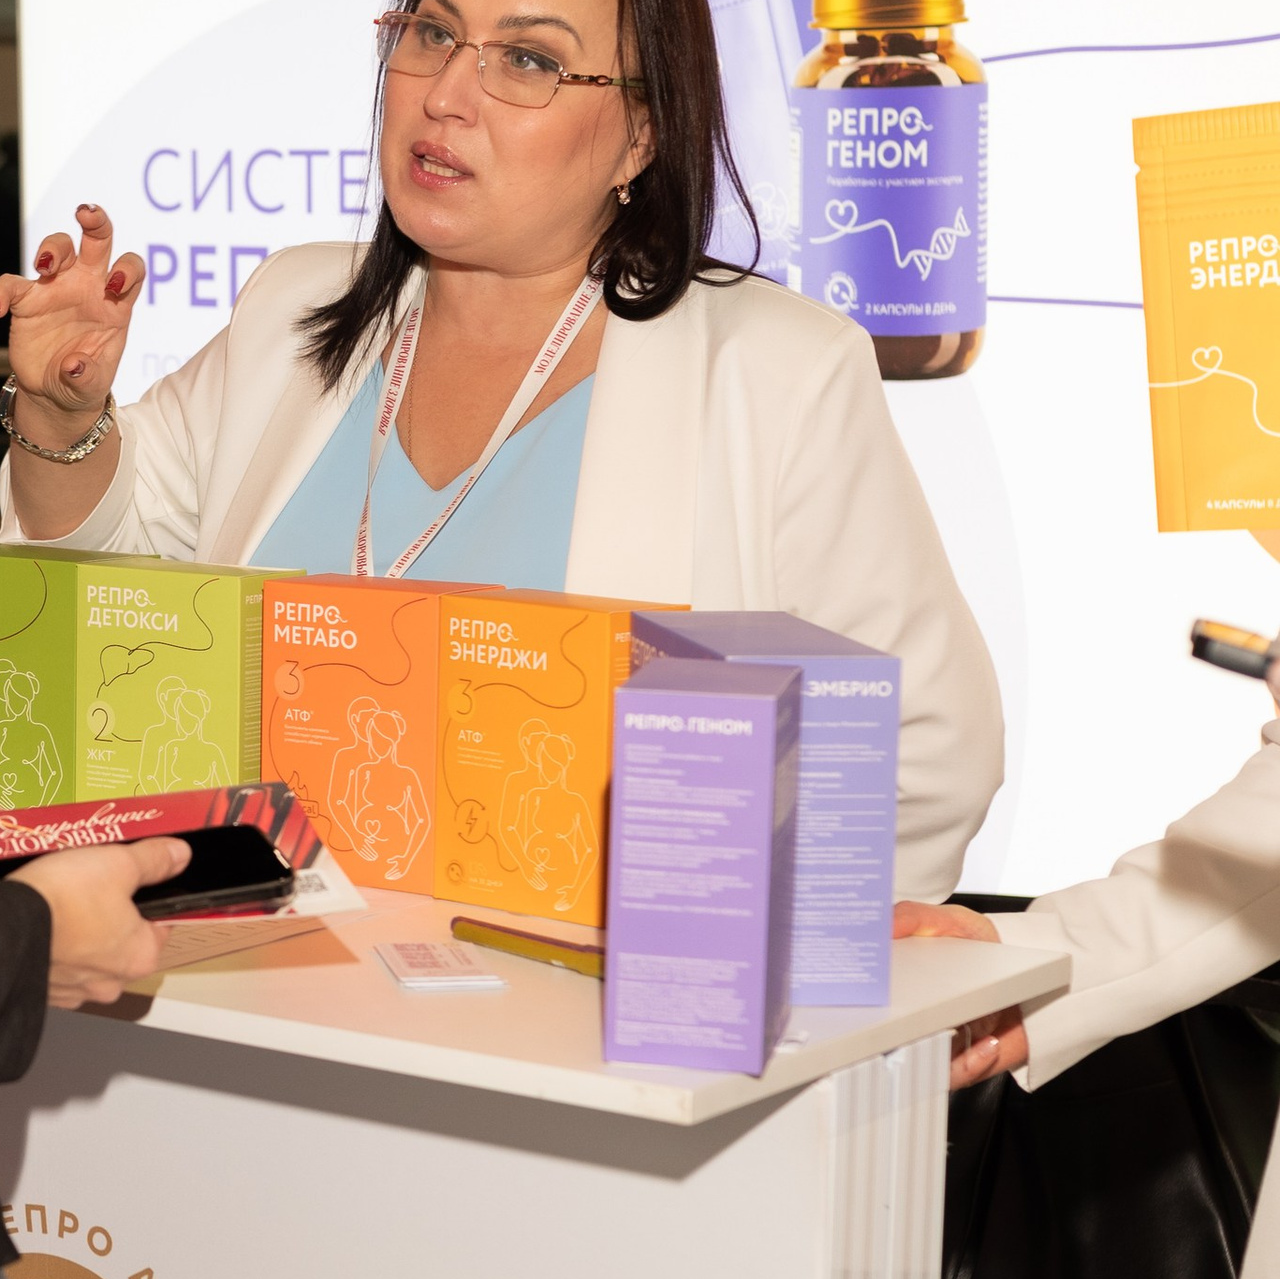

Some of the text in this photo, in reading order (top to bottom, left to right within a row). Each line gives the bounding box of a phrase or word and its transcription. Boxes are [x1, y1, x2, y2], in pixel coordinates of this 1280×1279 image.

[826, 106, 933, 137] РЕПРО
[826, 139, 928, 169] ГЕНОМ
[143, 149, 371, 215] СИСТЕ
[1189, 234, 1280, 264] РЕПРО
[146, 243, 269, 309] РЕП
[872, 302, 924, 316] КАПСУЛЫ
[932, 301, 958, 315] ДЕНЬ
[534, 291, 593, 376] МОДЕЛИРОВАНИЕ
[378, 307, 420, 436] МОДЕЛИРОВАНИЕ ЗДОРОВЬЯ
[1214, 498, 1266, 510] КАПСУЛЫ
[356, 526, 369, 577] ЗДОРОВЬЯ
[389, 521, 439, 578] ЕЛИРОВАНИЕ
[87, 585, 156, 608] РЕПРО
[245, 594, 262, 605] РЕПР
[87, 607, 179, 632] ДЕТОКСИ
[274, 601, 348, 625] РЕПРО
[274, 624, 358, 650] МЕТАБО
[449, 617, 519, 643] РЕПРО
[449, 641, 548, 671] ЭНЕРДЖИ
[282, 660, 300, 696] 3
[806, 680, 894, 698] ЭМБРИО
[455, 678, 473, 715] 3
[91, 707, 114, 743] 2
[624, 712, 754, 736] РЕПРО ГЕНОМ
[1, 1203, 114, 1258] ЕПРО
